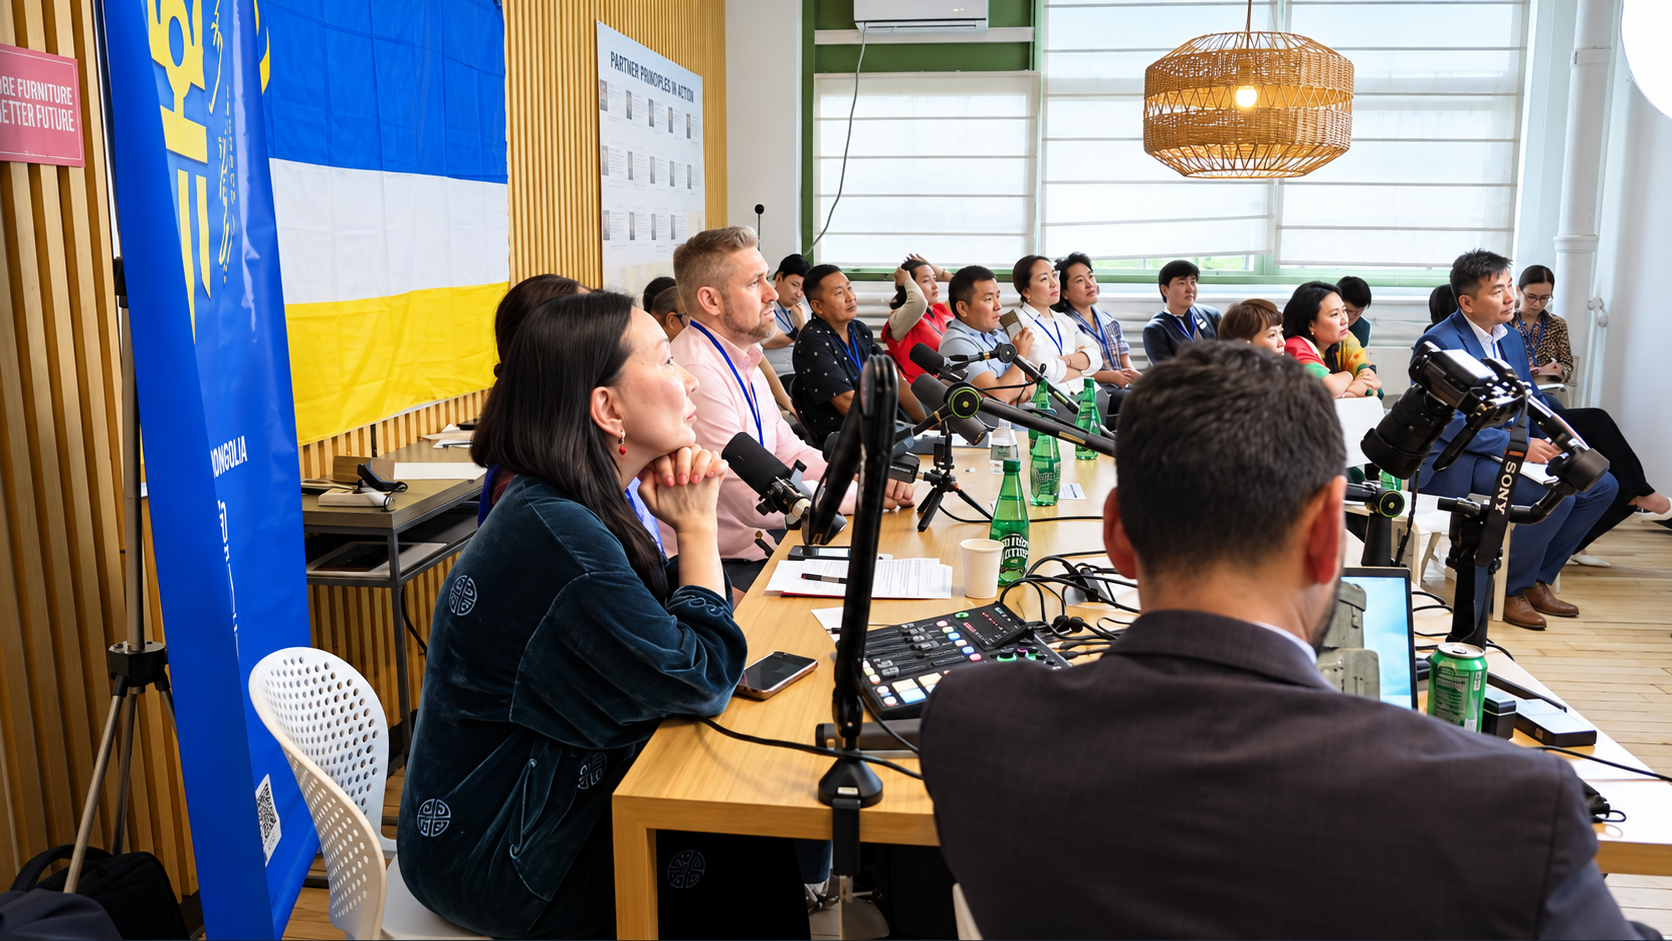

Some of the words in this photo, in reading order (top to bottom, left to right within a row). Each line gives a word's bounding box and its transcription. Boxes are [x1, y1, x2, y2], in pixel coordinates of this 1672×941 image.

[17, 78, 73, 106] FURNITURE
[610, 51, 639, 79] PARTNER
[678, 83, 694, 103] ACTION
[36, 104, 75, 132] FUTURE
[210, 435, 248, 479] ONGOLIA
[1494, 461, 1517, 515] SONY
